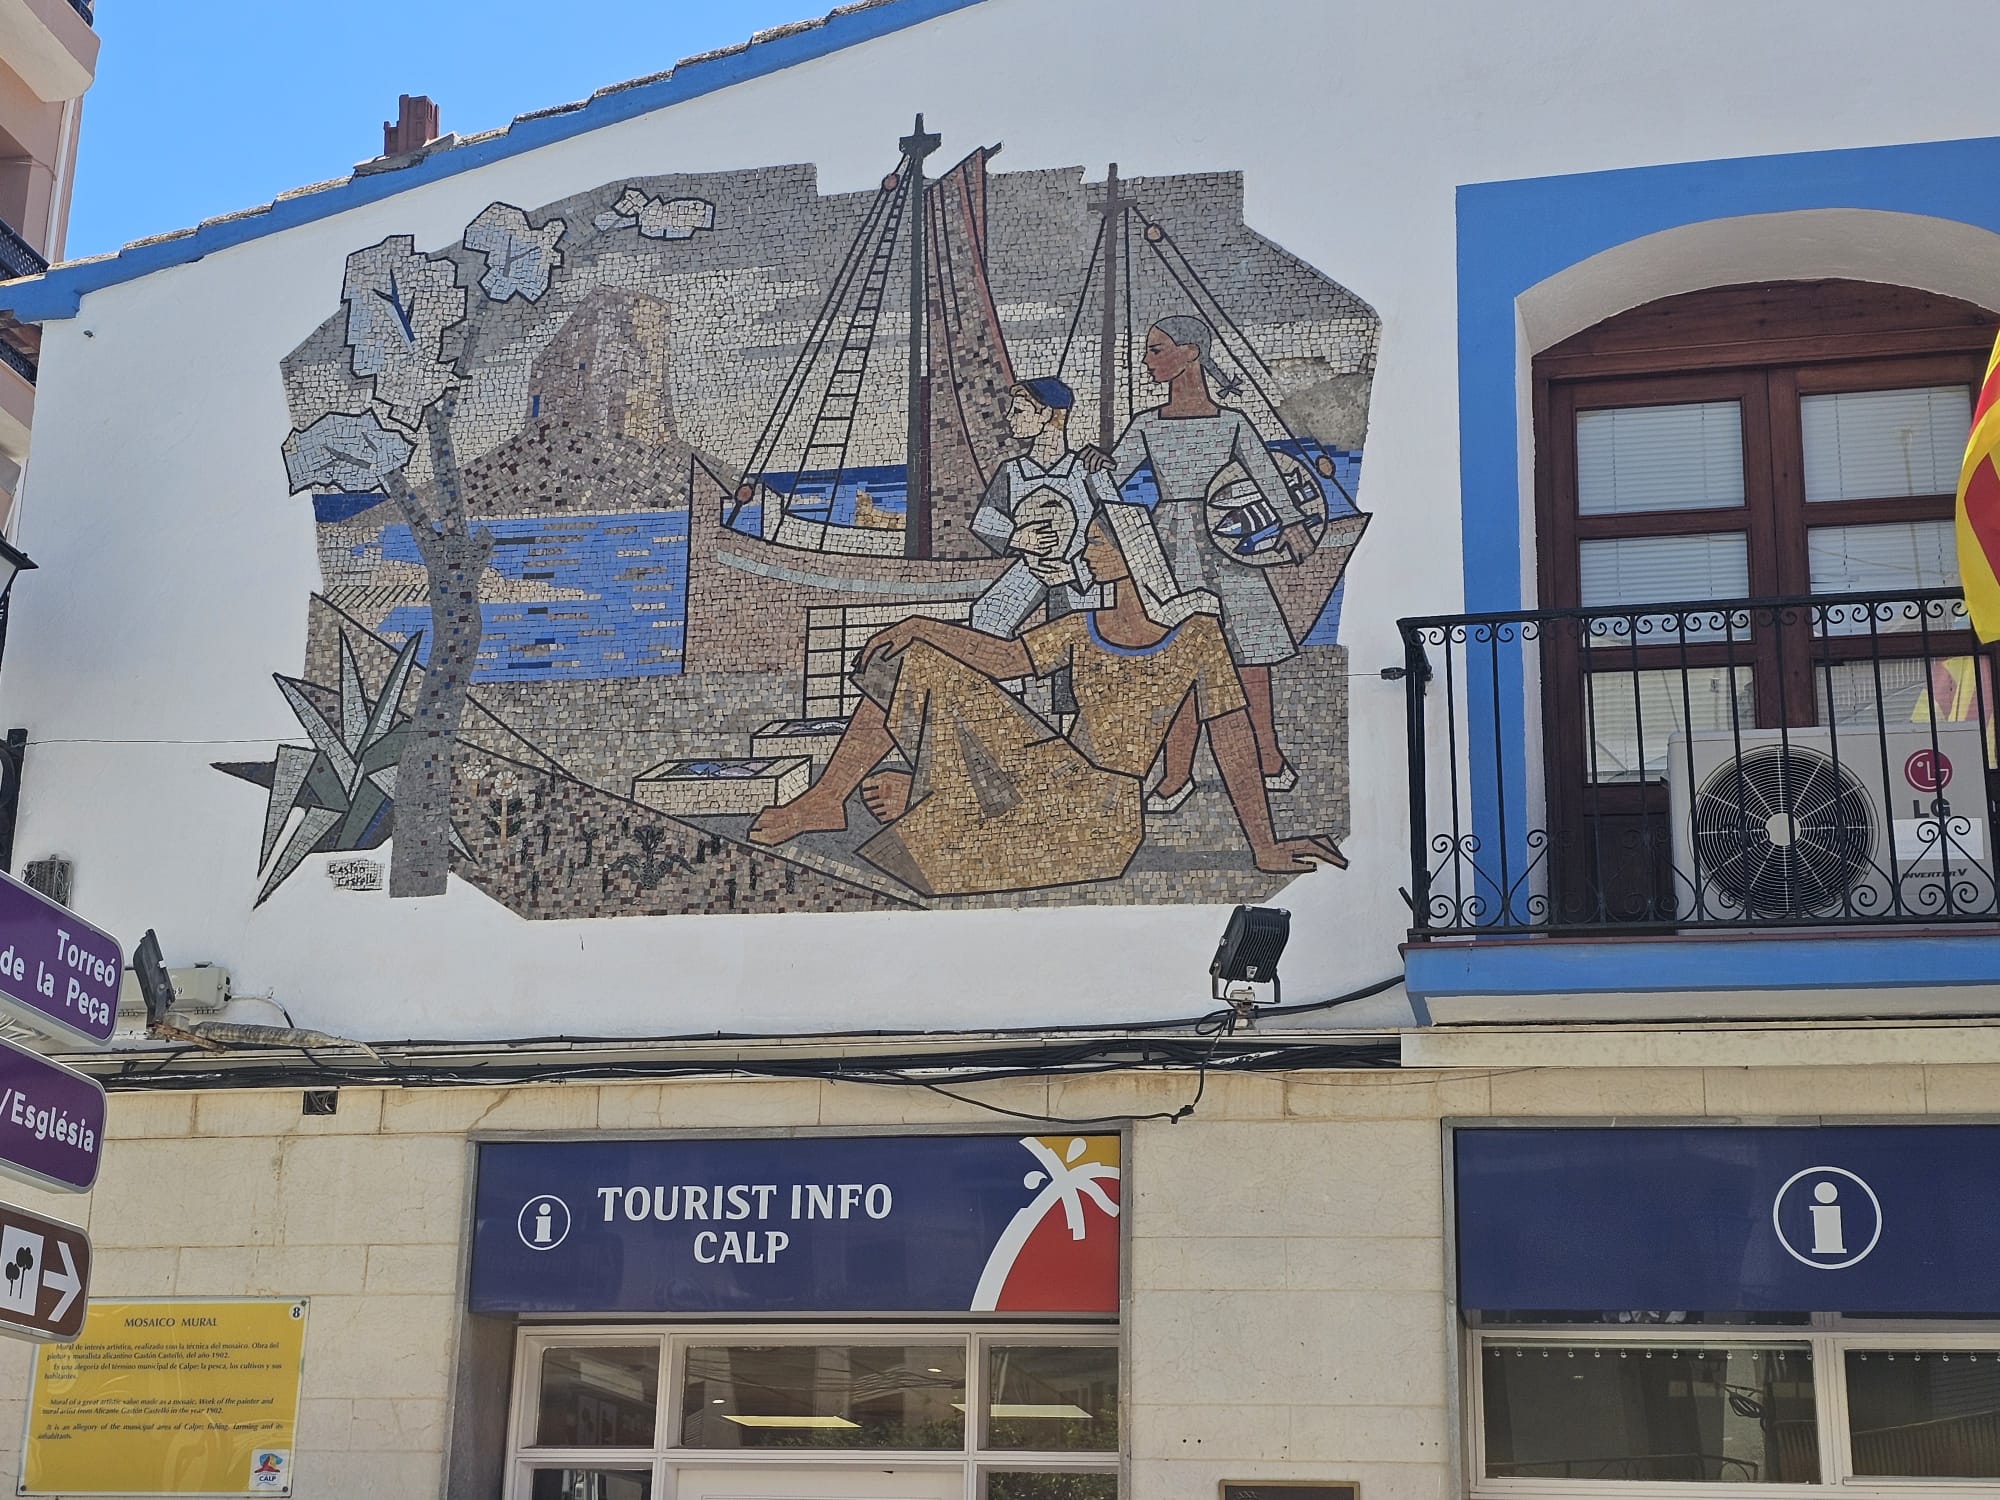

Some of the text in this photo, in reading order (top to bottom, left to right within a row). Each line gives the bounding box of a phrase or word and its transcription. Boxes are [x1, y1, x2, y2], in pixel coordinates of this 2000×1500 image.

[1913, 798, 1951, 818] LG
[57, 928, 116, 987] Torreó
[0, 945, 110, 1026] de la Peça
[597, 1184, 893, 1222] TOURIST INFO
[693, 1231, 789, 1264] CALP
[124, 1317, 218, 1327] MOSAICO MURAL
[292, 1307, 301, 1318] 8
